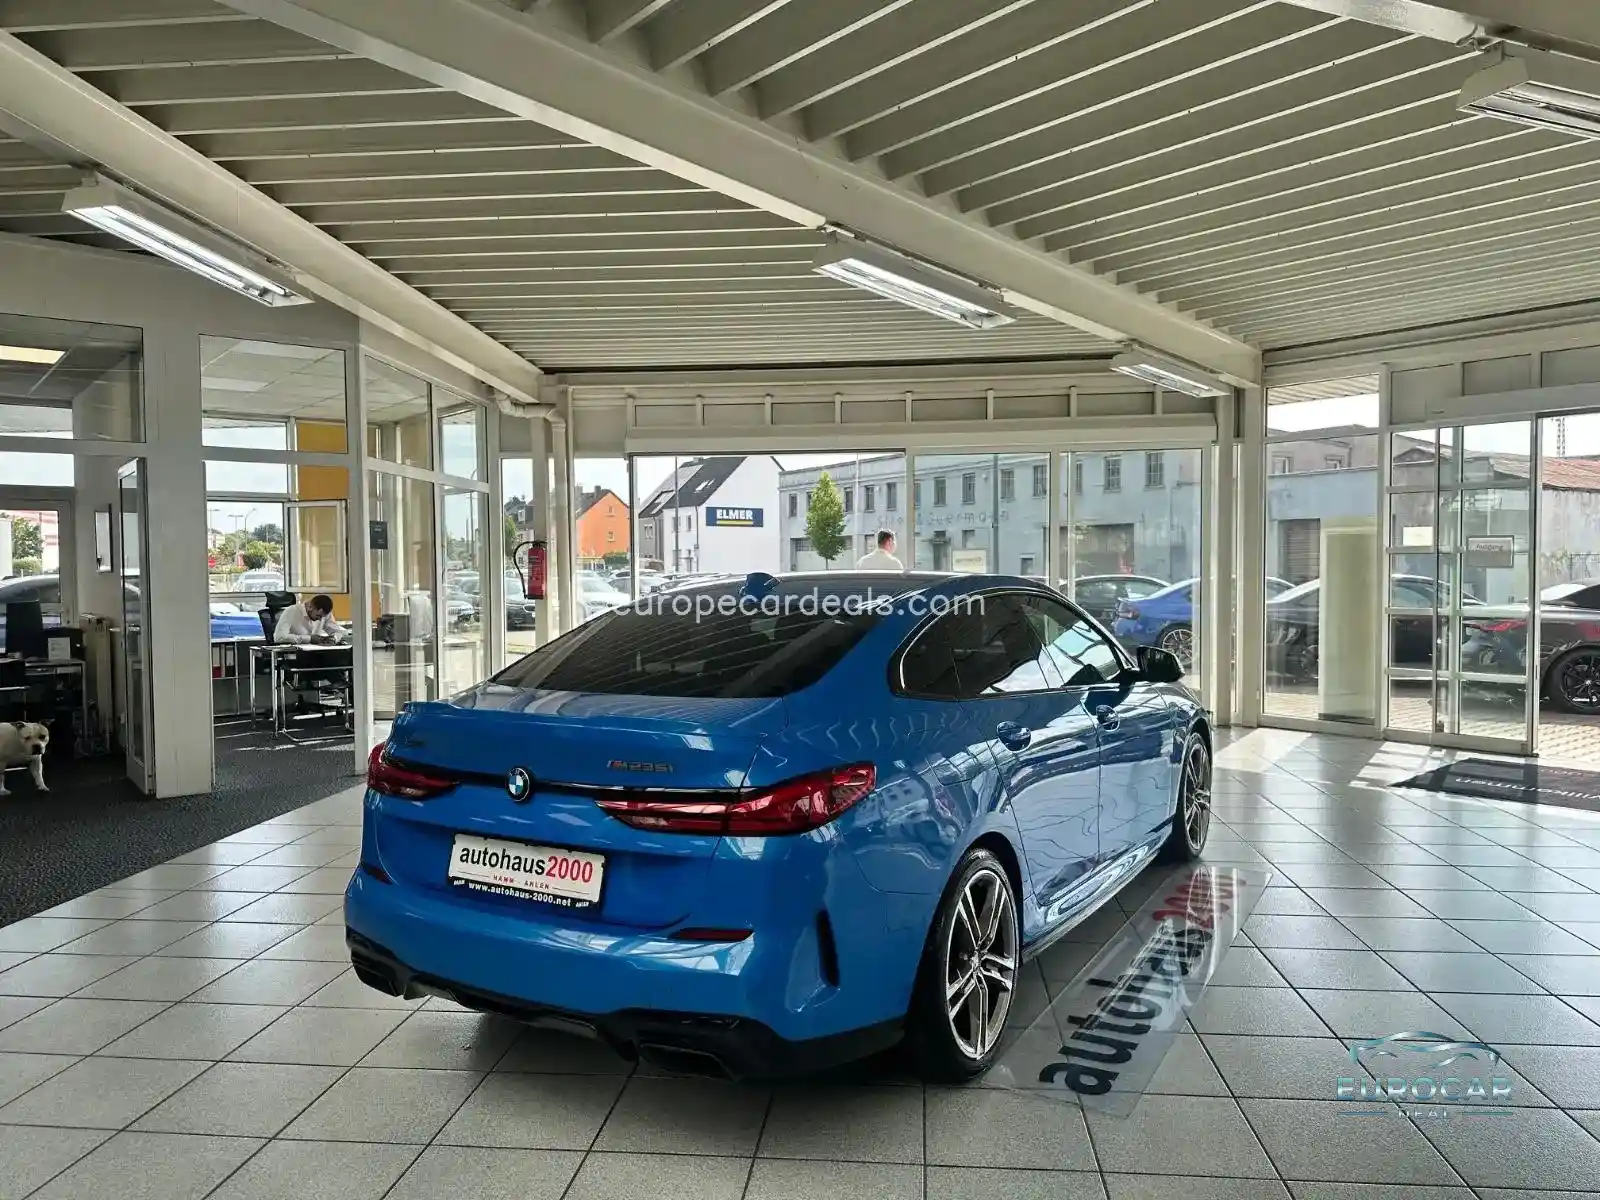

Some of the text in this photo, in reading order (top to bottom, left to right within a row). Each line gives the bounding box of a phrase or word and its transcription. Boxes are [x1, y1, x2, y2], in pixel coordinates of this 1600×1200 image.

[716, 508, 754, 520] ELMER
[459, 847, 593, 883] autohaus2000
[468, 881, 571, 907] www.autohaus-2000.net
